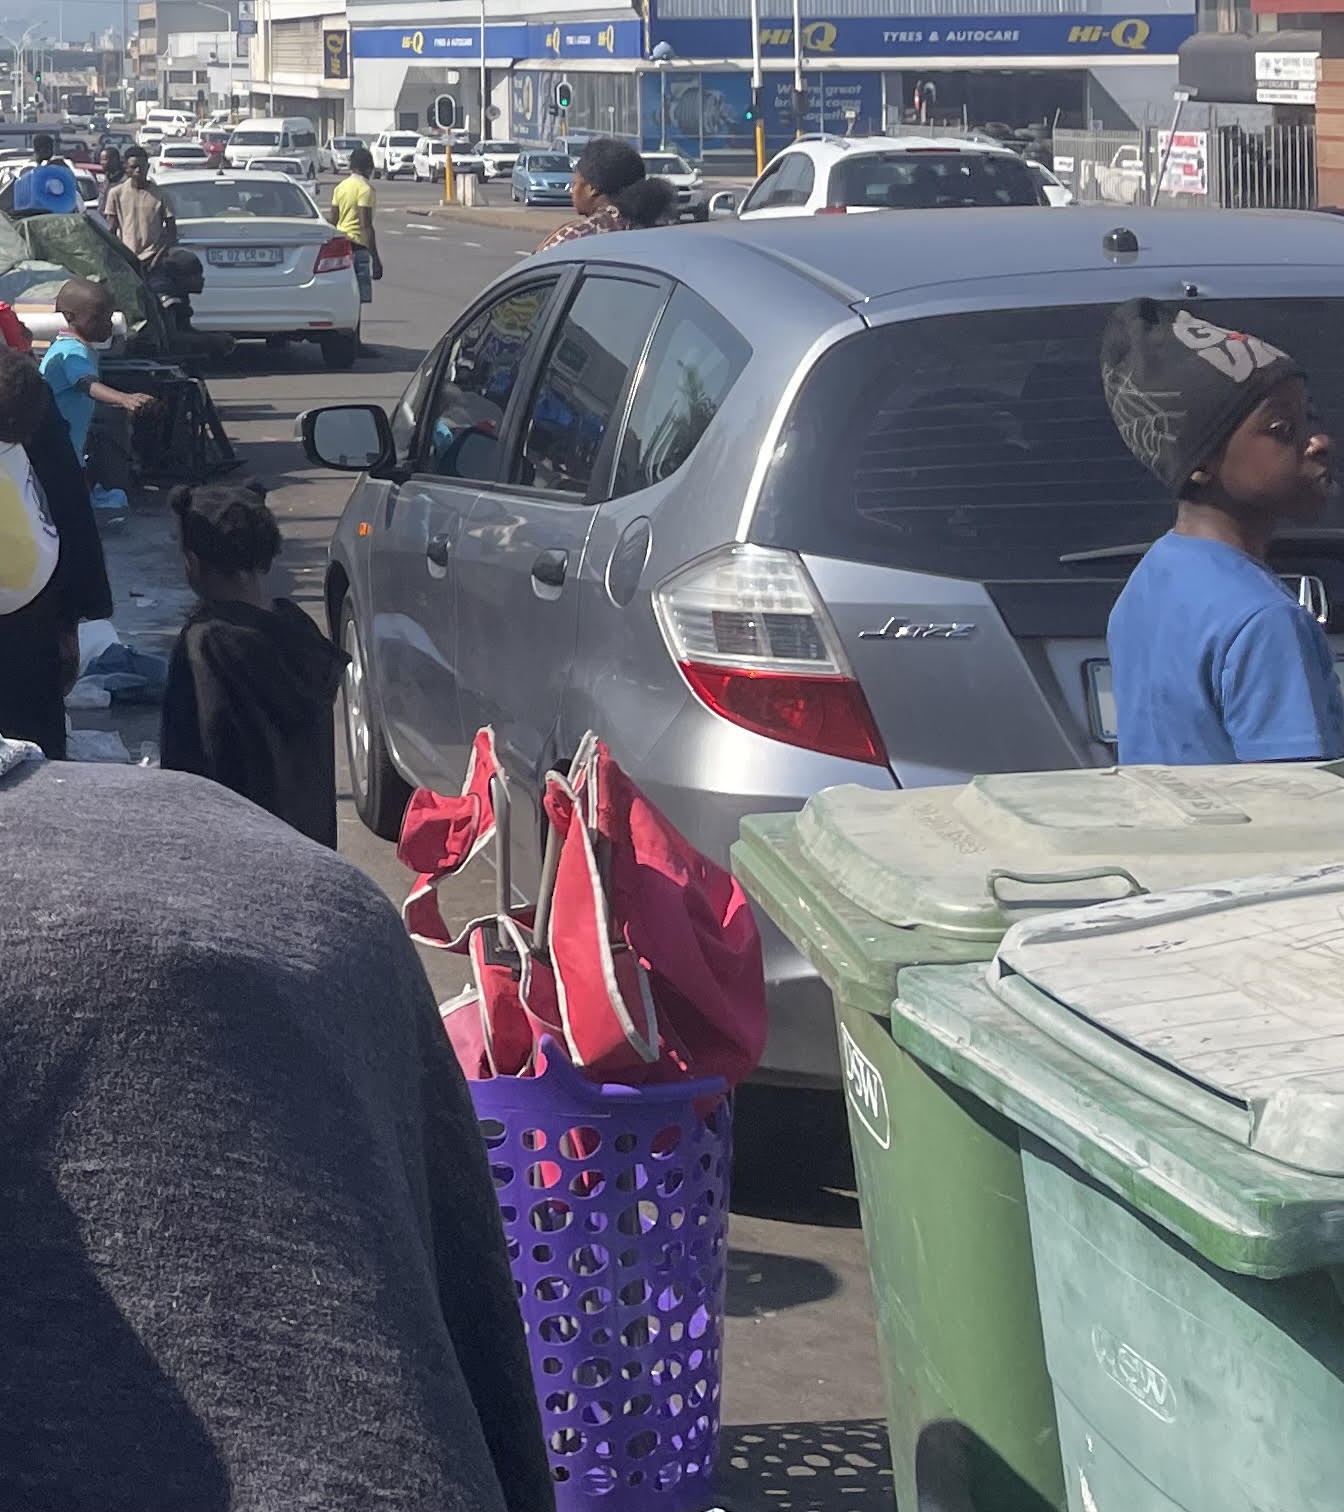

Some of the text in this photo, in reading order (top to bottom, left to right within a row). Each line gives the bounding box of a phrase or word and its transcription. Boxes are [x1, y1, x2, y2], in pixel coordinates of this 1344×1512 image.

[883, 31, 923, 42] TYRES
[946, 30, 1020, 42] AUTOCARE
[1067, 19, 1150, 49] Hi-Q
